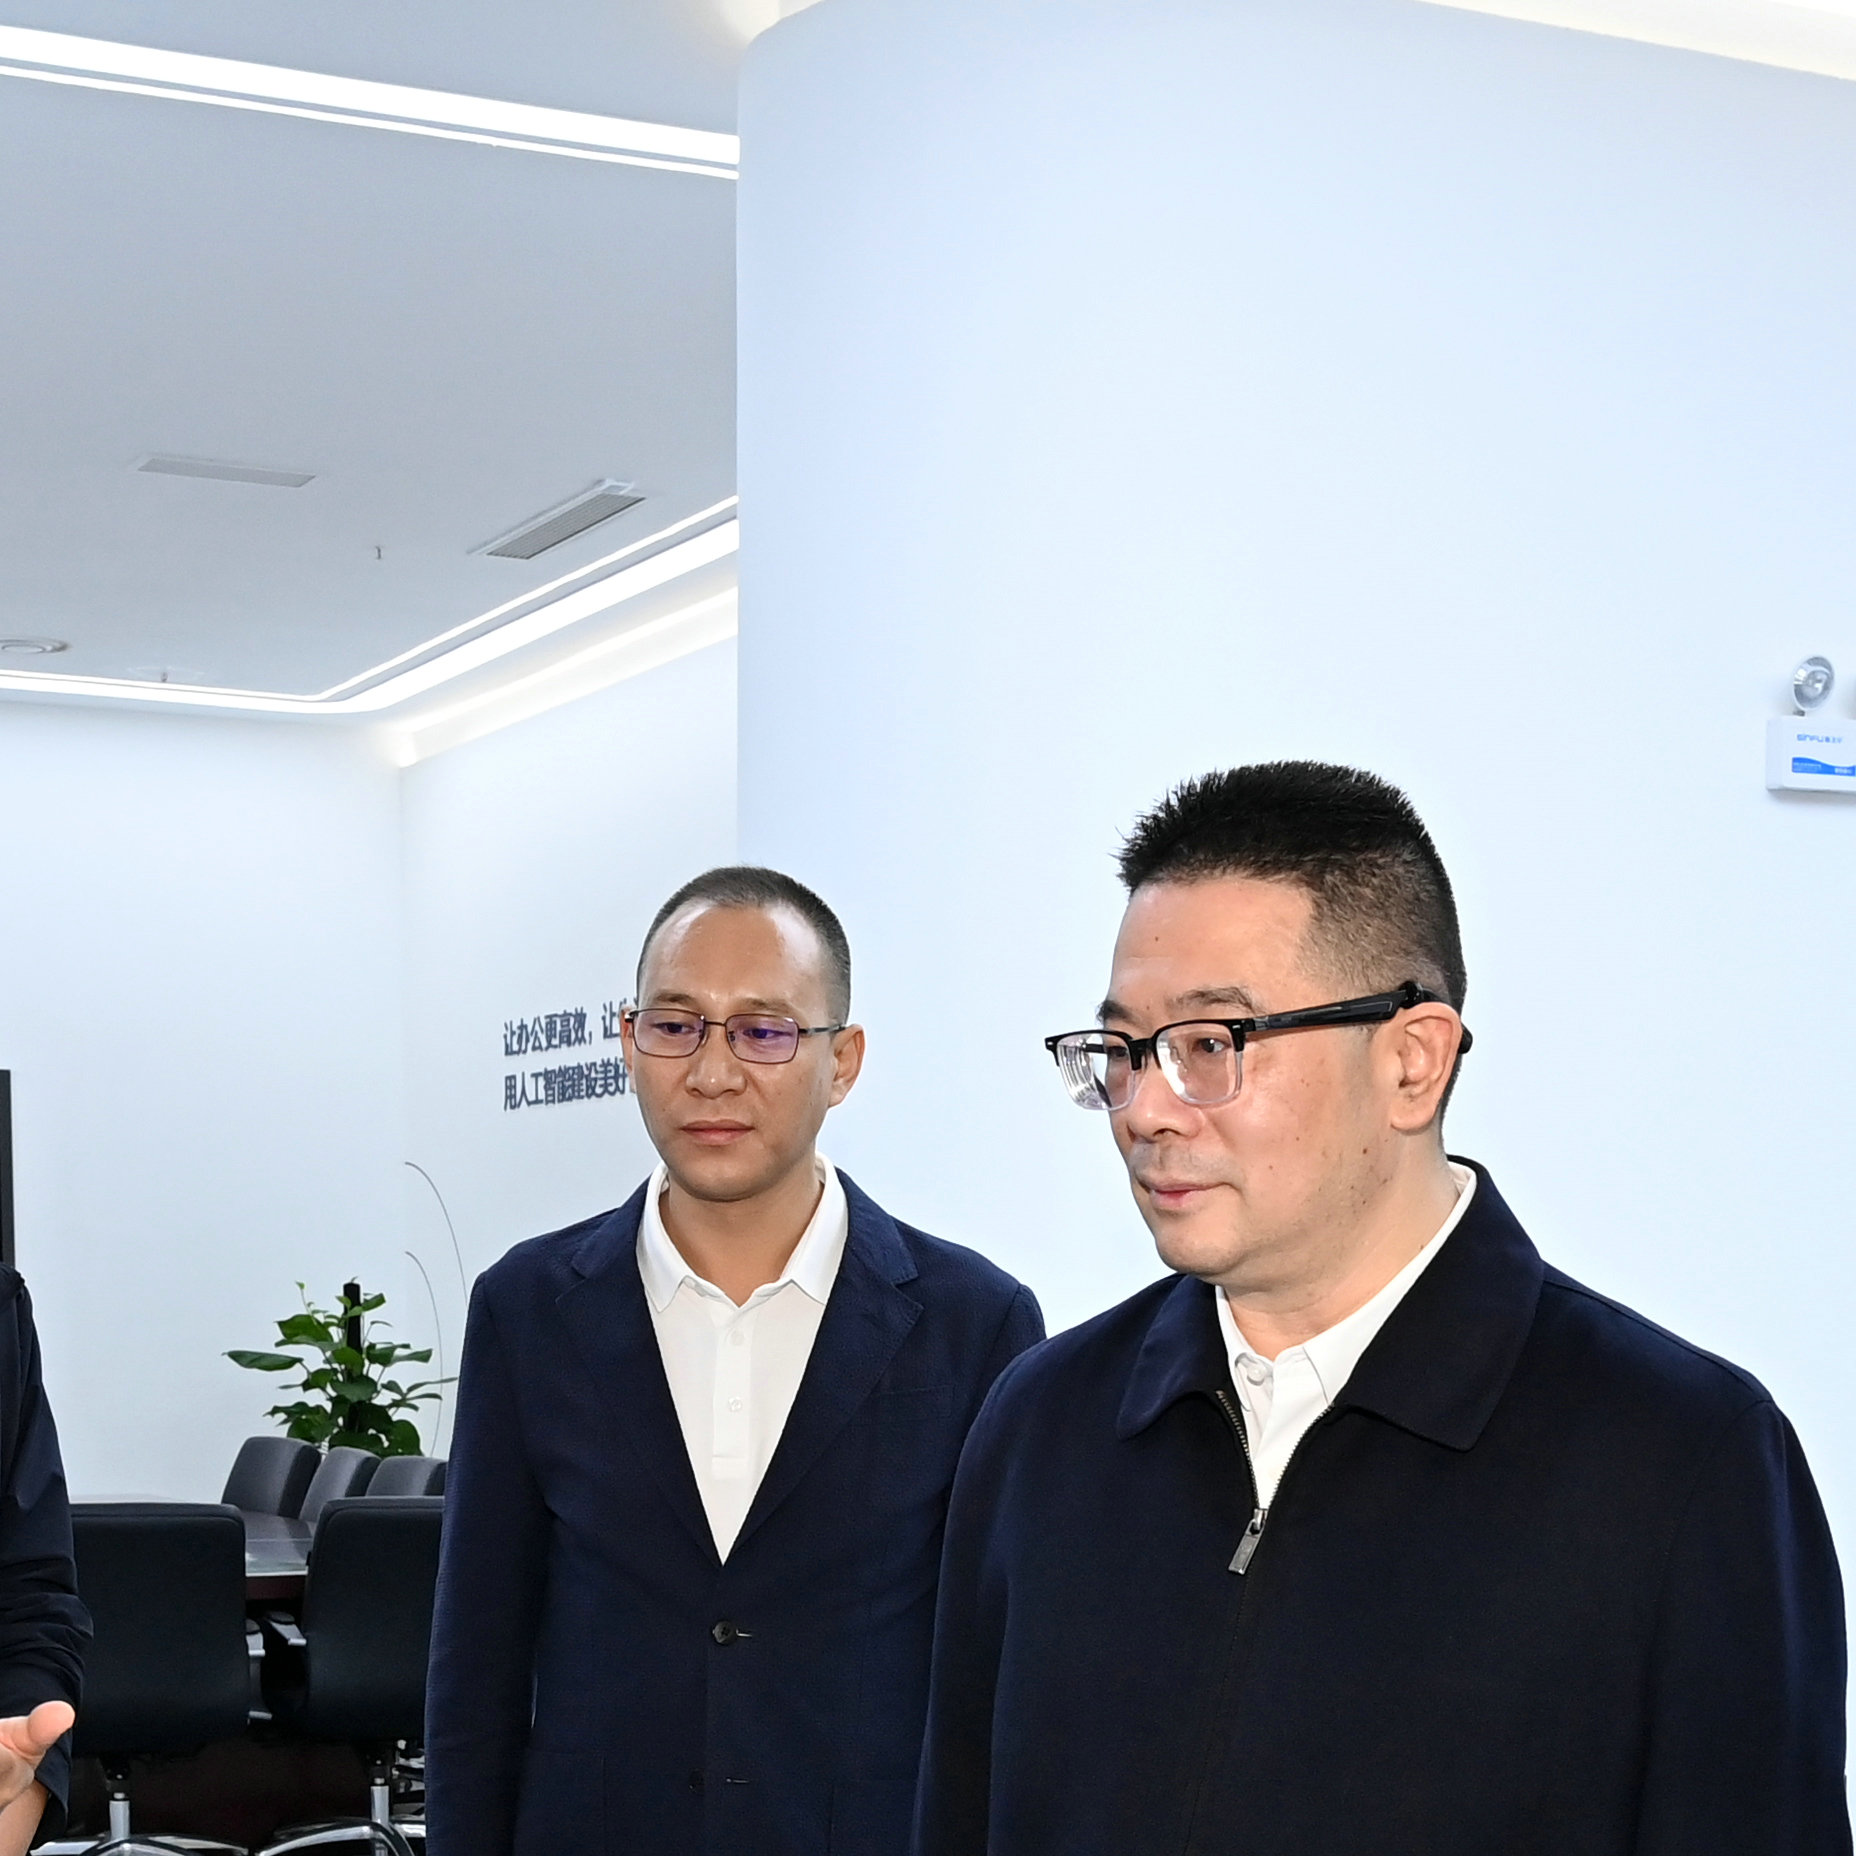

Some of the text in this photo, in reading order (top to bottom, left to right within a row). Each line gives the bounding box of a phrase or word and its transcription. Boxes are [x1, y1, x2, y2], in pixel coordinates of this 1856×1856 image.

[504, 1000, 625, 1056] 让办公更高效，让
[504, 1056, 628, 1111] 用人工智能建设美好
